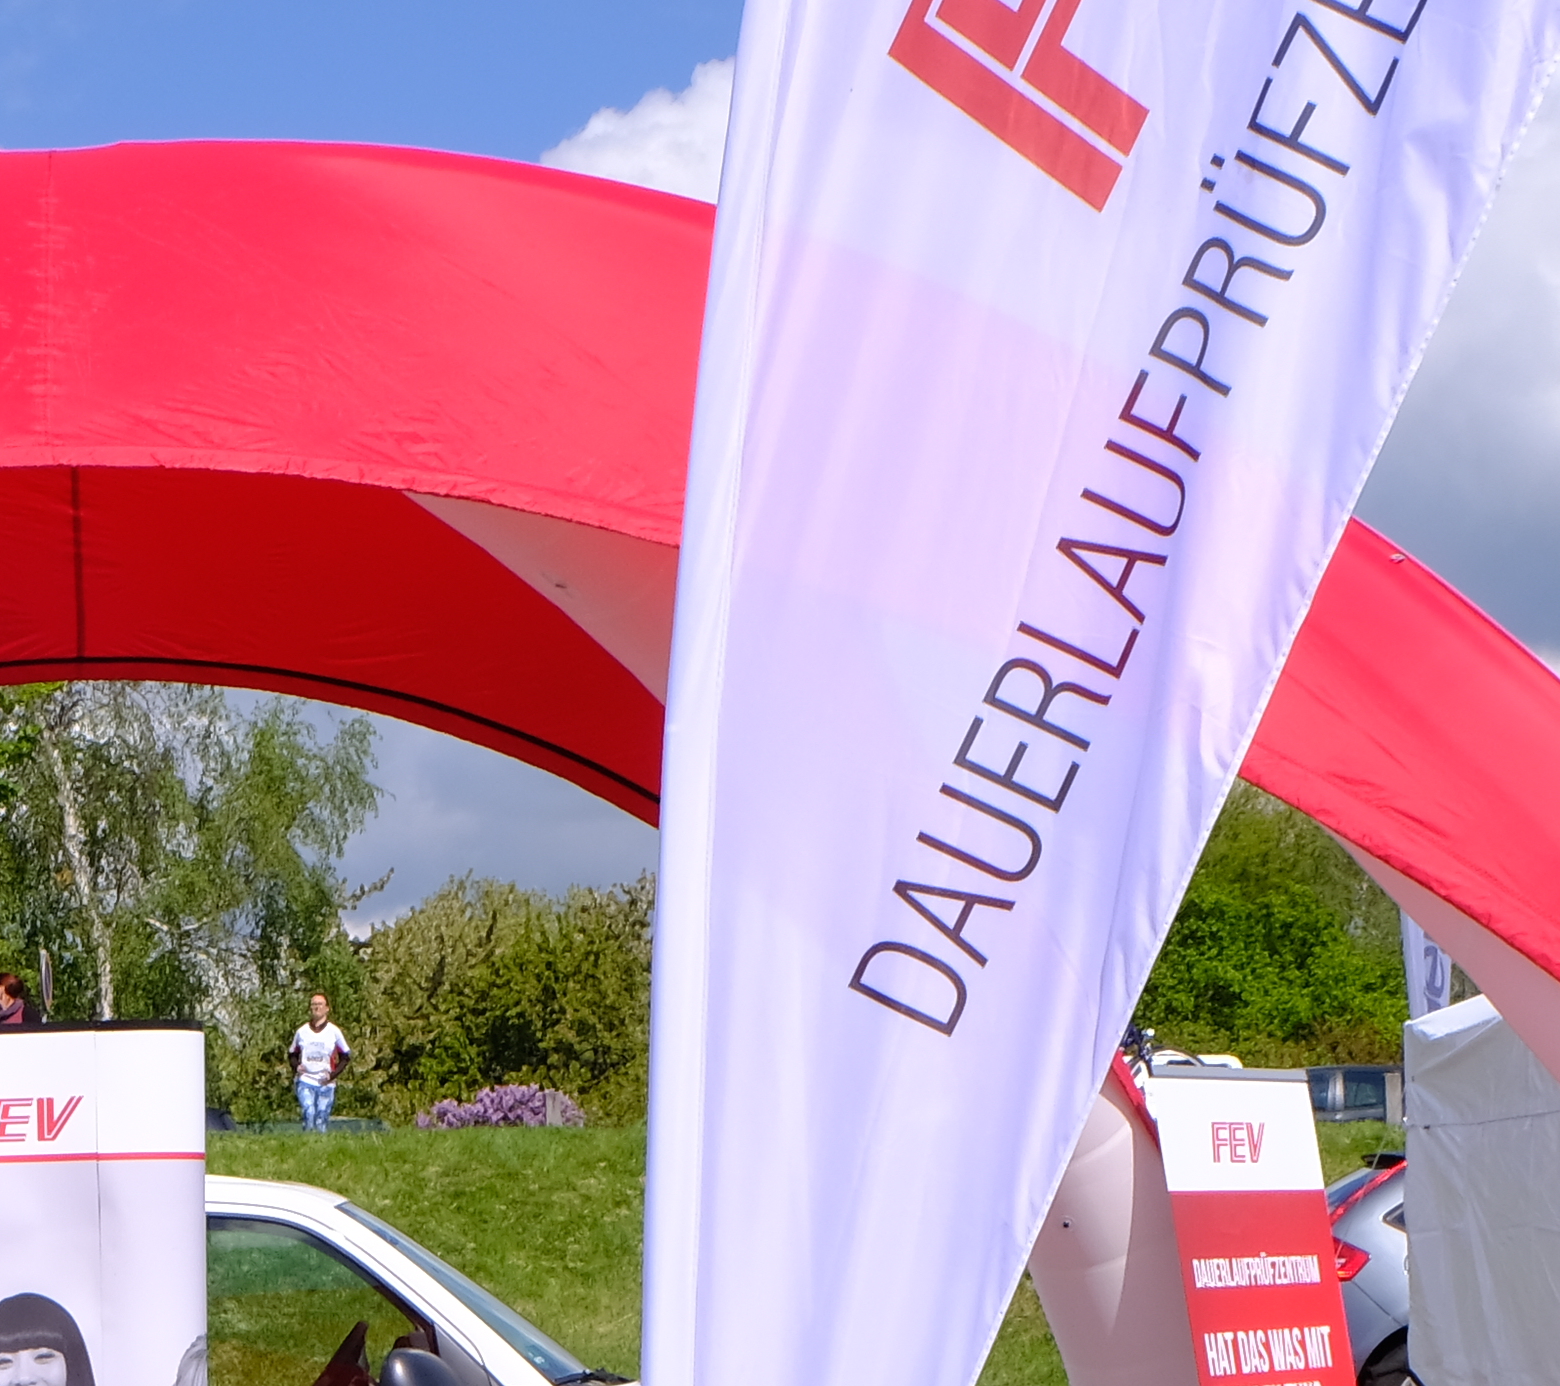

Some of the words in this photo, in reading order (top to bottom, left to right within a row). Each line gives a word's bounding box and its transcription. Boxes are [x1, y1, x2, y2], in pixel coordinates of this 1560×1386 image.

[1211, 1122, 1265, 1163] FEV
[1192, 1252, 1321, 1288] DAUERLAUFPRÜFZENTRUM
[1204, 1332, 1236, 1376] HAT
[1237, 1329, 1269, 1374] DAS
[1268, 1328, 1305, 1371] WAS
[1304, 1326, 1332, 1368] MIT
